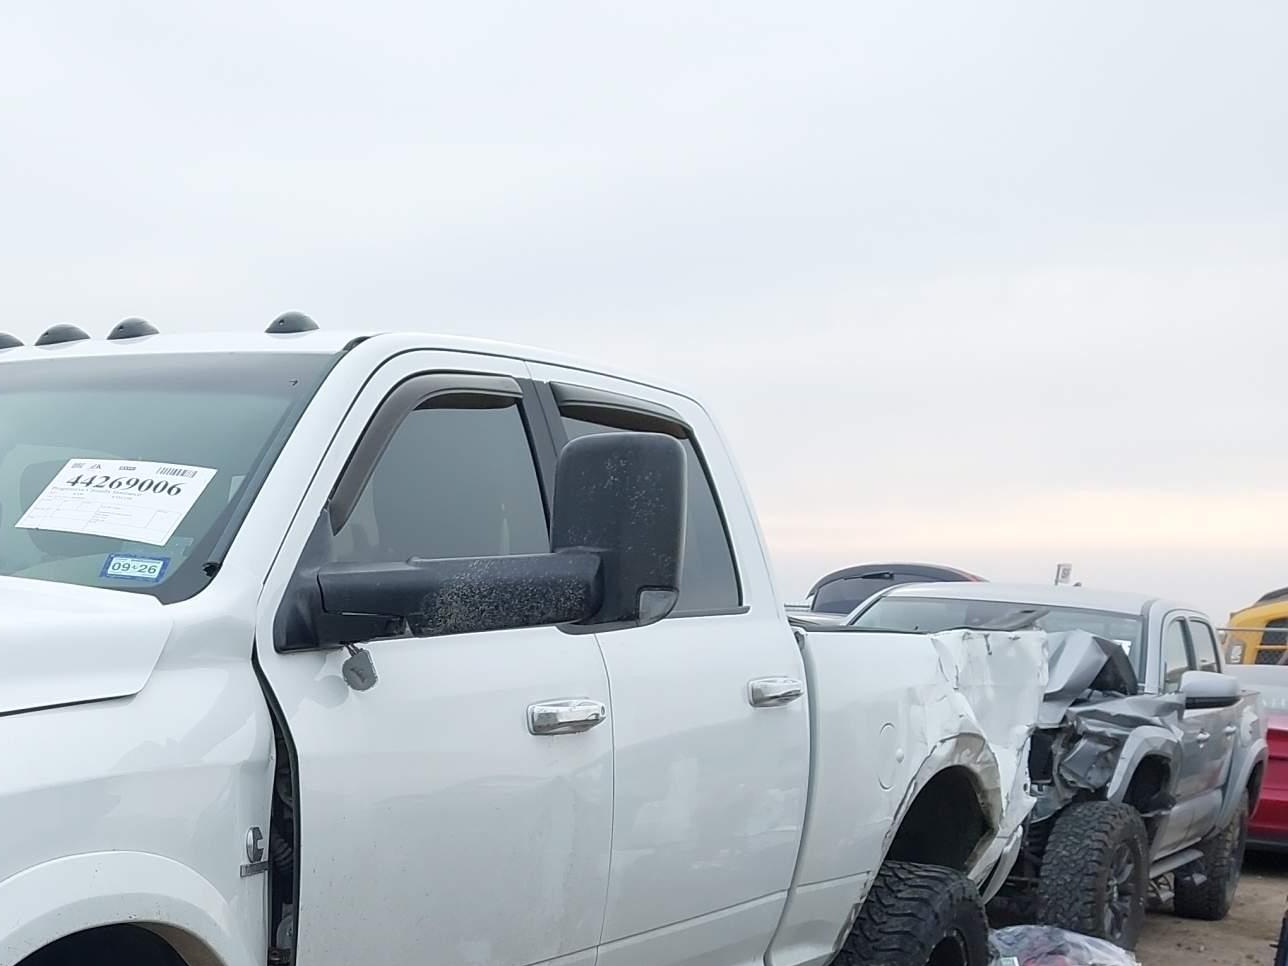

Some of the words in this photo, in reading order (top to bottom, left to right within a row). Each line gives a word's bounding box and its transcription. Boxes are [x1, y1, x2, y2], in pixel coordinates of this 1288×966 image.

[66, 474, 187, 497] 44269006
[111, 562, 131, 572] 09
[136, 564, 158, 575] 26
